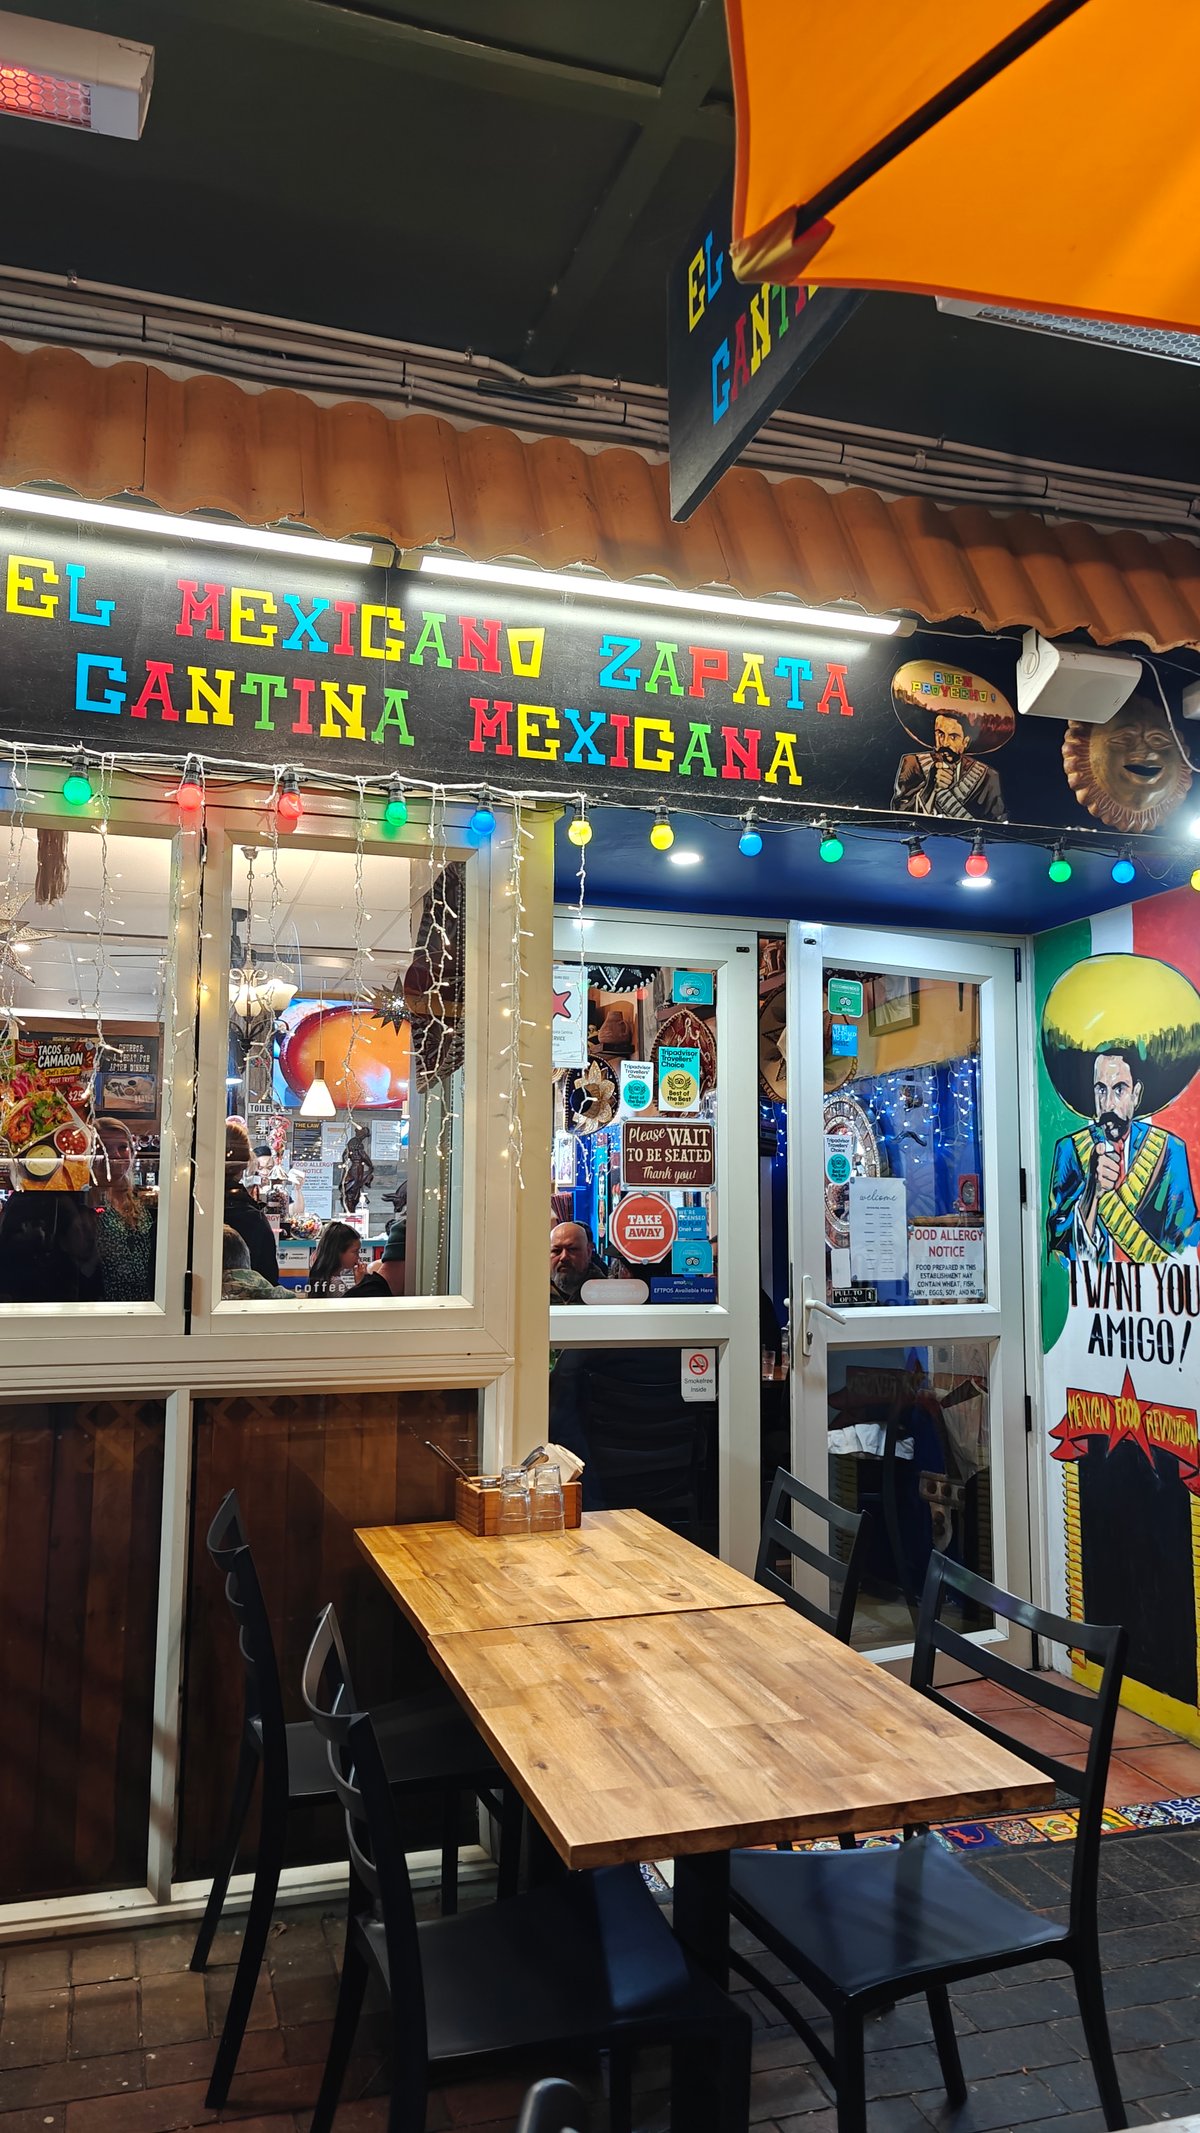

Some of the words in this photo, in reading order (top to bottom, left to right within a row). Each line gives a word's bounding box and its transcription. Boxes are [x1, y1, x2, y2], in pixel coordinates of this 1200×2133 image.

[688, 230, 723, 333] EL
[6, 554, 115, 627] EL
[176, 579, 546, 678] MEXICANO
[599, 634, 854, 717] ZAPATA
[934, 671, 973, 688] BUEN
[75, 652, 415, 746] CANTINA
[469, 697, 803, 786] MEXICANA
[38, 1044, 61, 1056] TACOS
[661, 1048, 698, 1056] Tripadvisor
[38, 1052, 83, 1068] CAMARON
[661, 1061, 685, 1069] Choice
[629, 1126, 666, 1143] Please
[666, 1128, 710, 1147] WAIT
[626, 1148, 644, 1162] TO
[646, 1148, 662, 1162] BE
[664, 1149, 712, 1163] SEATED
[642, 1165, 672, 1180] Thank
[674, 1169, 697, 1184] you!
[859, 1189, 897, 1202] welcome
[627, 1214, 663, 1225] TAKE
[628, 1228, 662, 1238] AWAY
[908, 1229, 937, 1241] FOOD
[940, 1229, 984, 1242] ALLERGY
[928, 1245, 965, 1258] NOTICE
[294, 1281, 346, 1293] coffee
[1069, 1260, 1078, 1307] I
[1082, 1260, 1145, 1312] WANT
[1150, 1262, 1200, 1317] YOU
[1067, 1394, 1111, 1431] MEXICAN
[1114, 1397, 1141, 1432] FOOD
[1145, 1409, 1198, 1449] REVOLUTION
